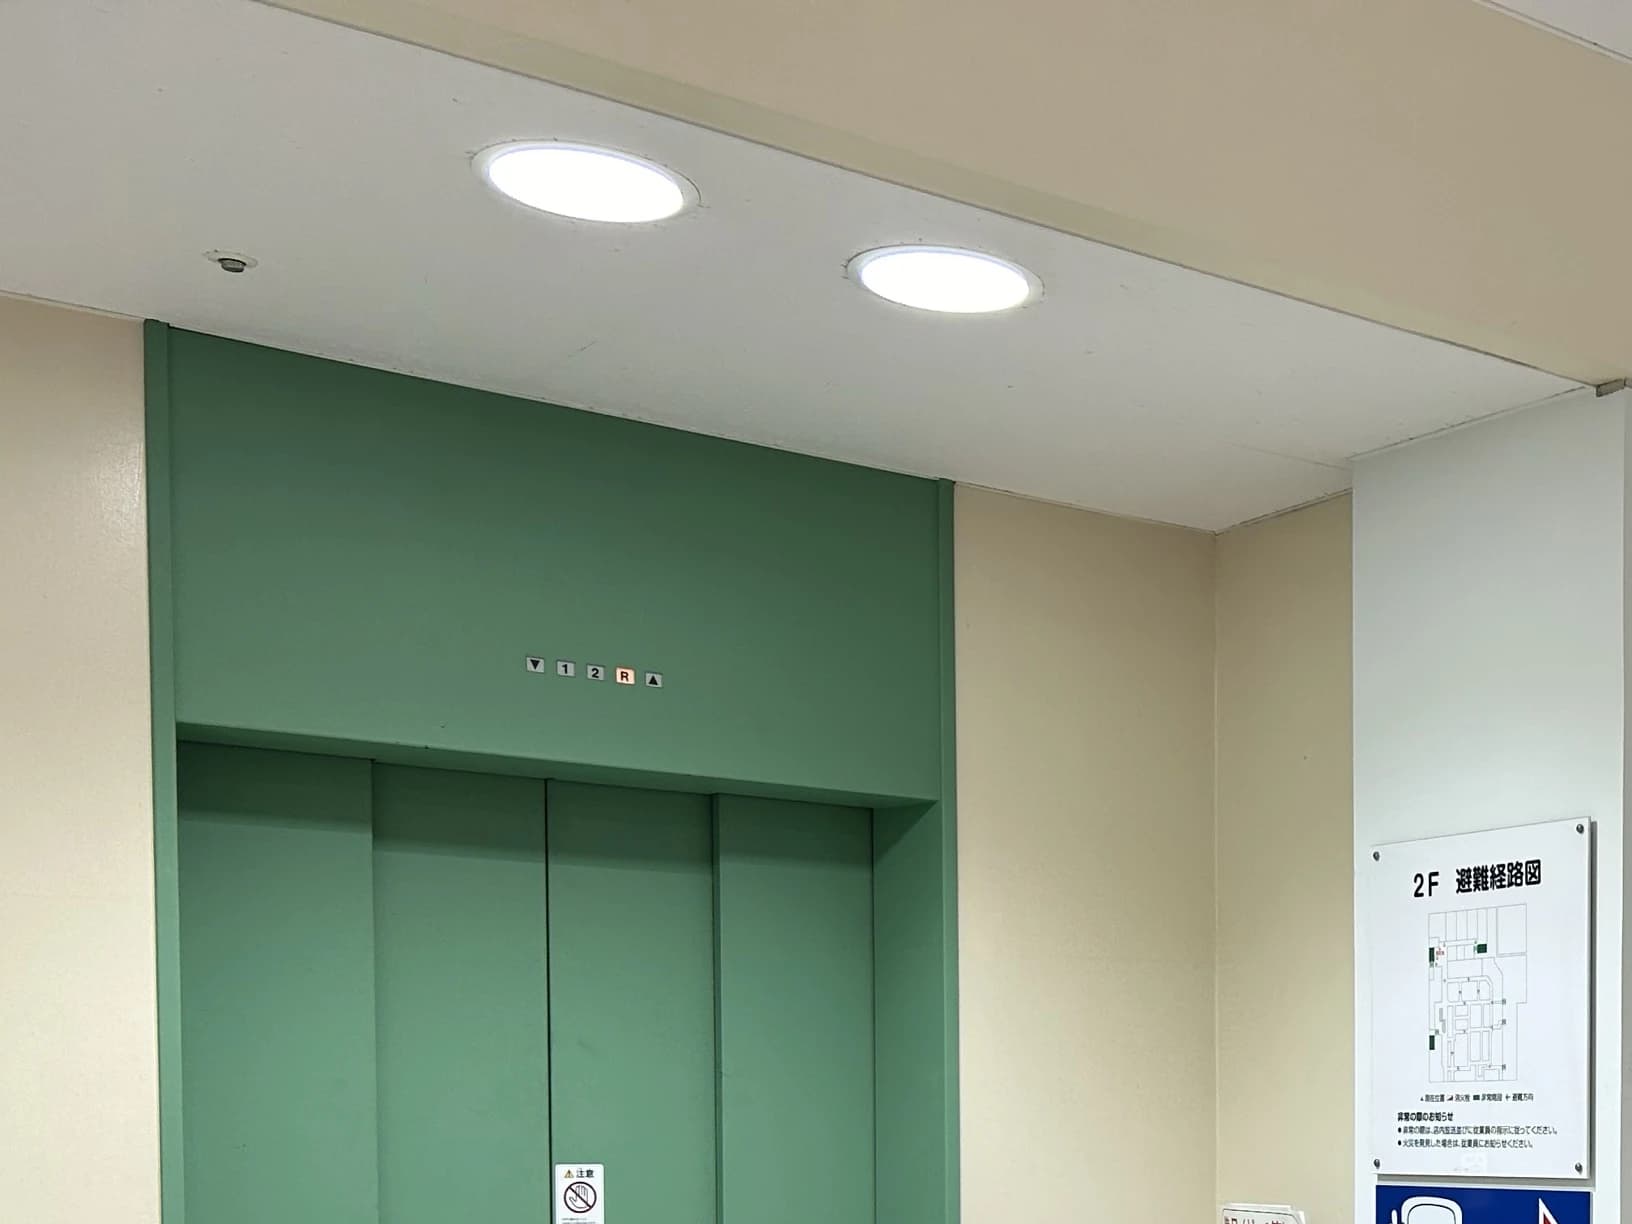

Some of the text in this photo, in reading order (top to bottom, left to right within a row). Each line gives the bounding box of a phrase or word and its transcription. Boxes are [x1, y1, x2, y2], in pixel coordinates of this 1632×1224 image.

[1413, 859, 1542, 898] 2F 避難経路図
